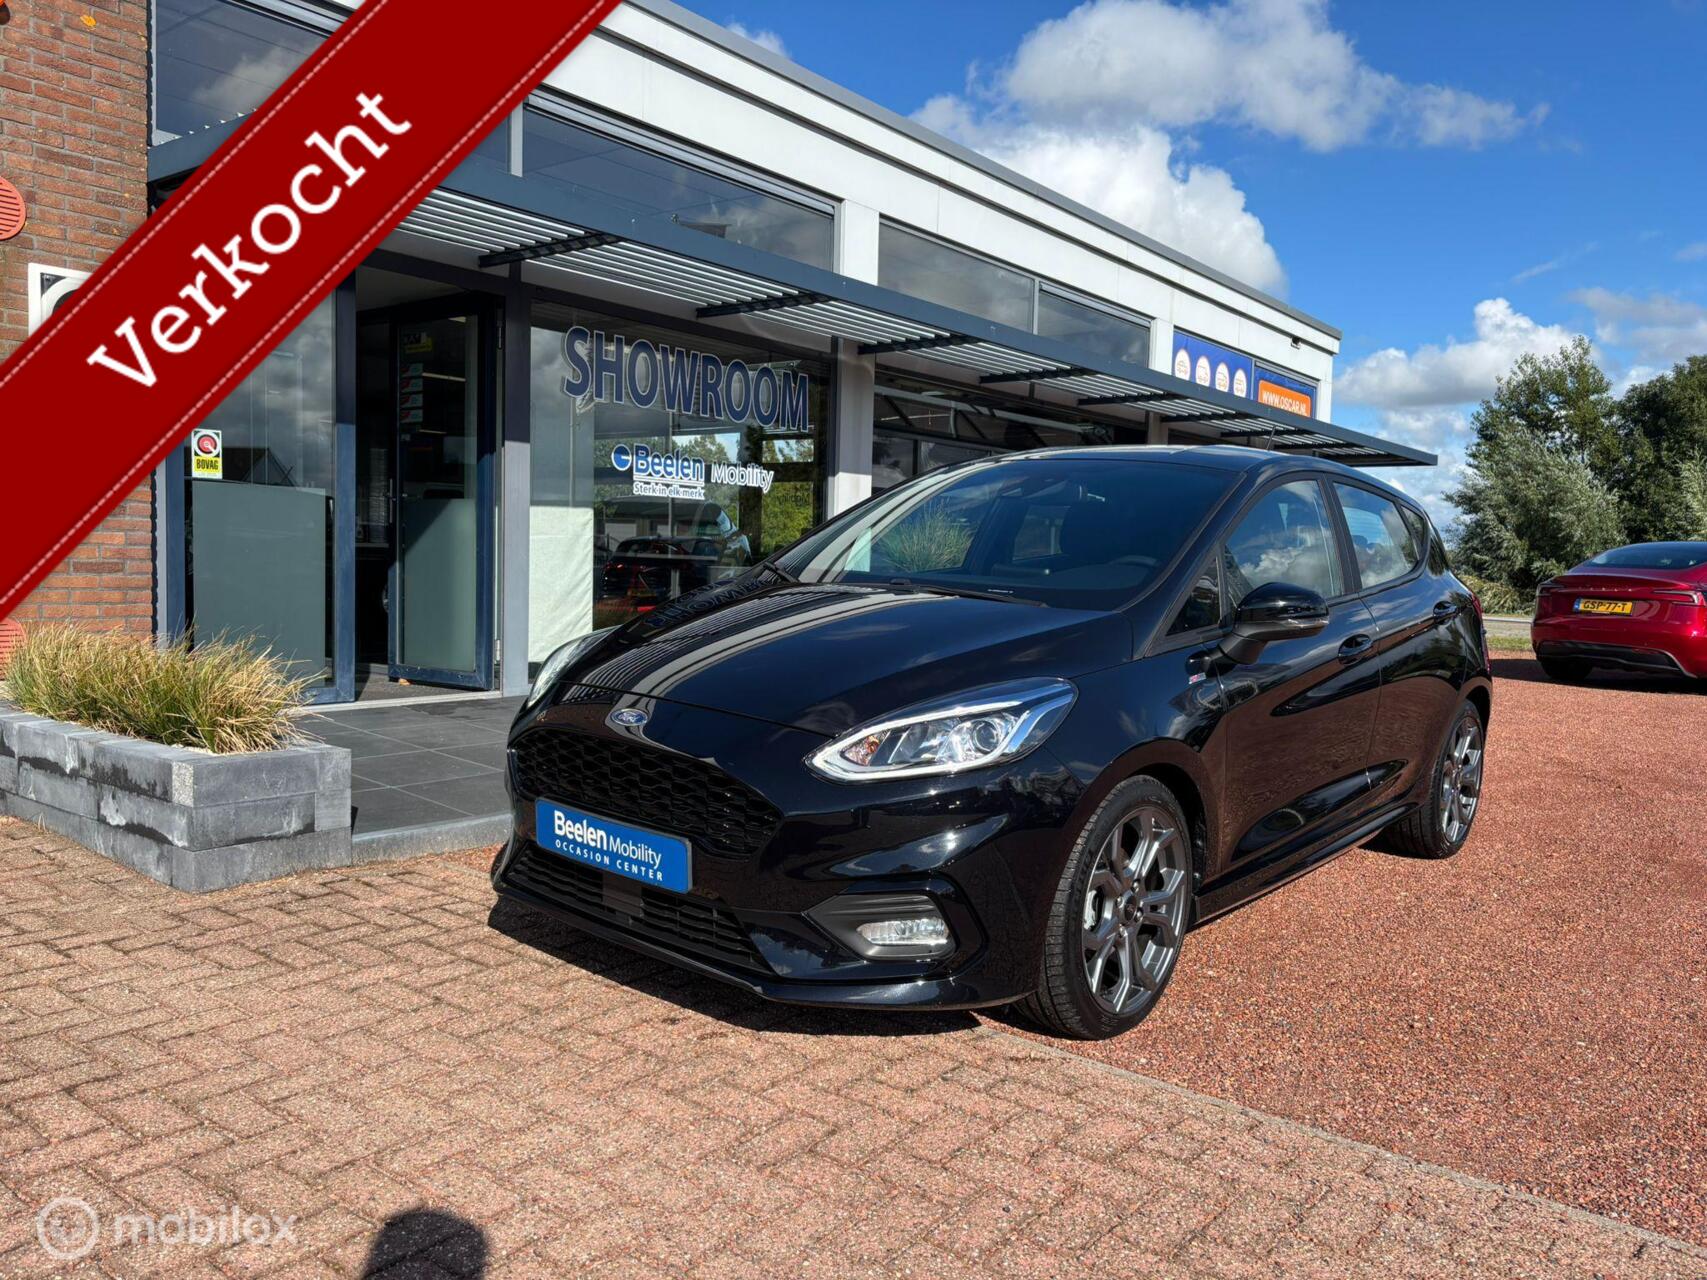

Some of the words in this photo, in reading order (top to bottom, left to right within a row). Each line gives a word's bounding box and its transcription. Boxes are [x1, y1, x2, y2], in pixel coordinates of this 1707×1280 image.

[562, 325, 810, 433] SHOWROOM
[196, 458, 219, 470] BOVAG
[633, 444, 705, 480] Beelen
[711, 460, 775, 494] Mobility
[1583, 600, 1628, 612] GSP-77-T
[554, 810, 607, 851] Beelen
[609, 835, 662, 871] Mobility
[555, 839, 610, 866] OCCASION
[616, 859, 664, 881] CENTER
